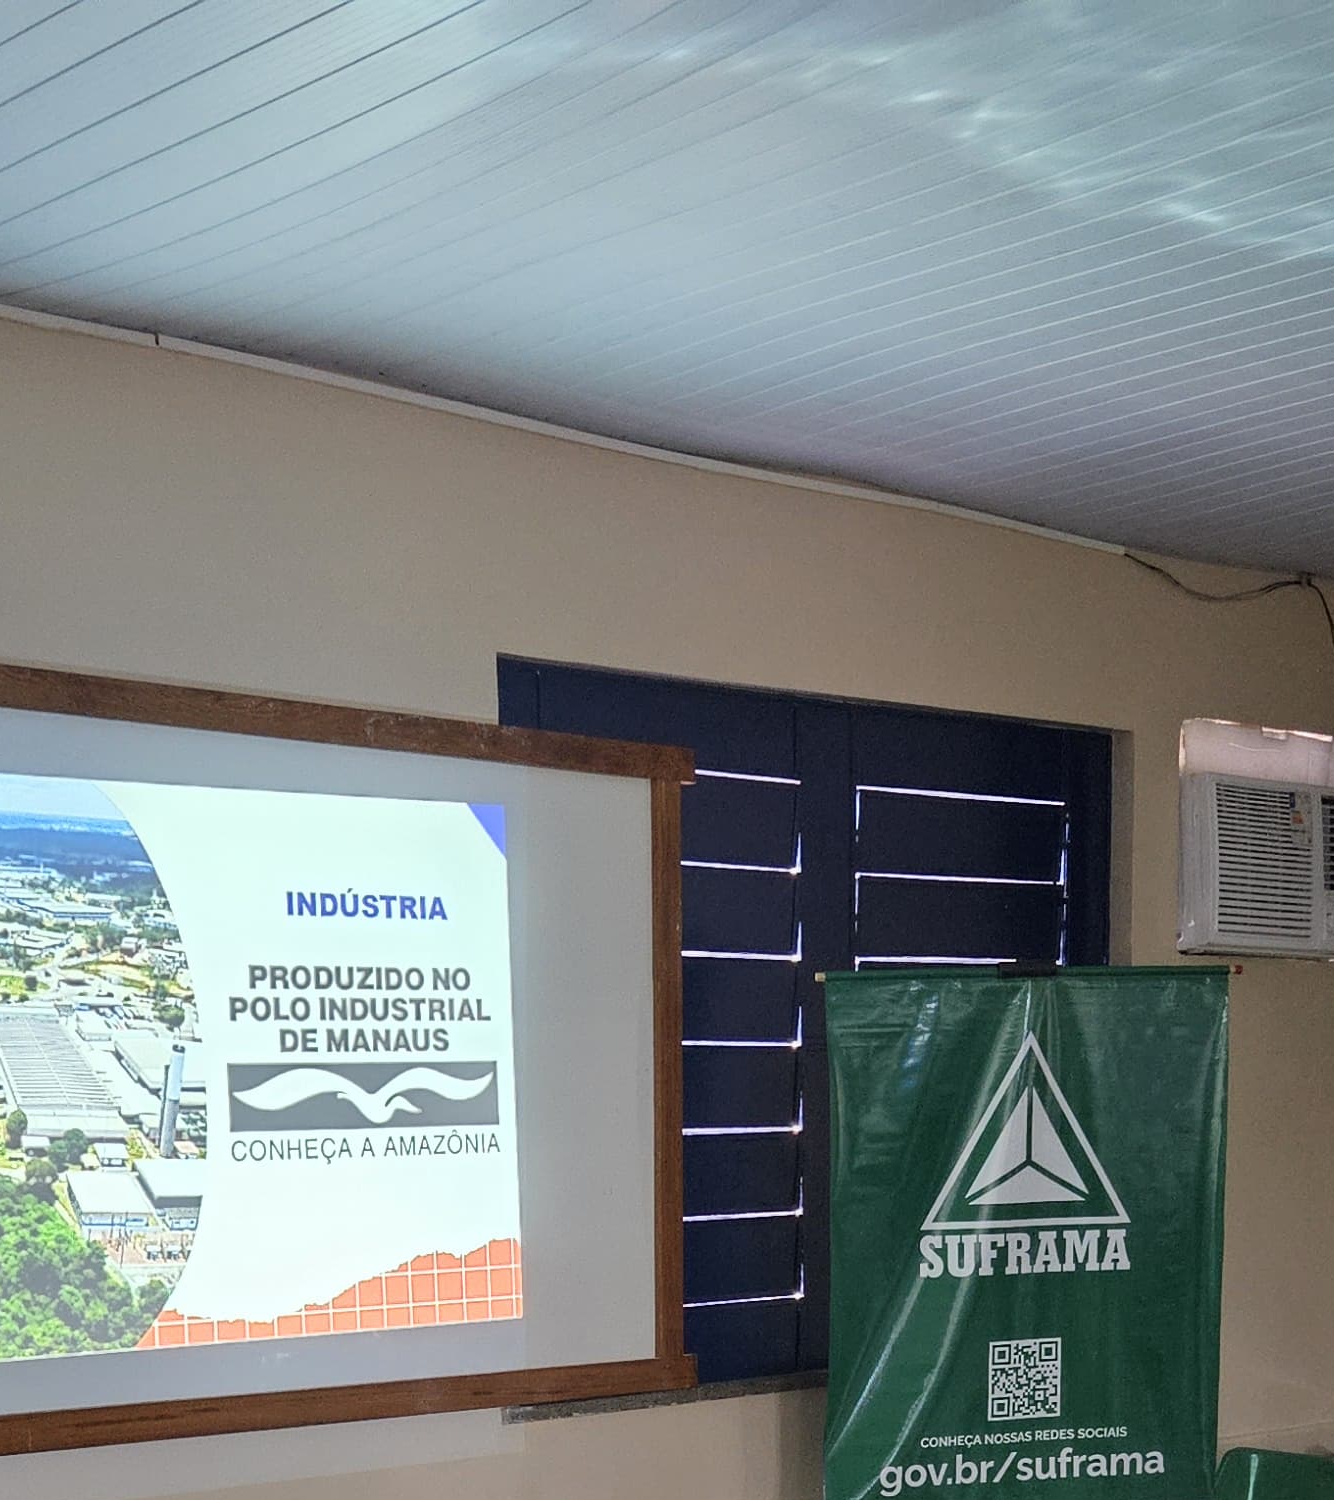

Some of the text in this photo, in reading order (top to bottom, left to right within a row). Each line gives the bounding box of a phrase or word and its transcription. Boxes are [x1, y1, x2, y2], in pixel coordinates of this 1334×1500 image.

[286, 888, 448, 920] INDÚSTRIA
[248, 964, 471, 991] PRODUZIDO NO
[228, 996, 492, 1022] POLO INDUSTRIAL
[279, 1028, 449, 1053] DE MANAUS
[231, 1129, 501, 1165] CONHEÇA A AMAZÔNIA
[919, 1228, 1131, 1279] SUFRAMA
[920, 1426, 1128, 1448] CONHEÇA NOSSAS REDES SOCIAIS
[879, 1447, 1165, 1497] gov.br/suframa
